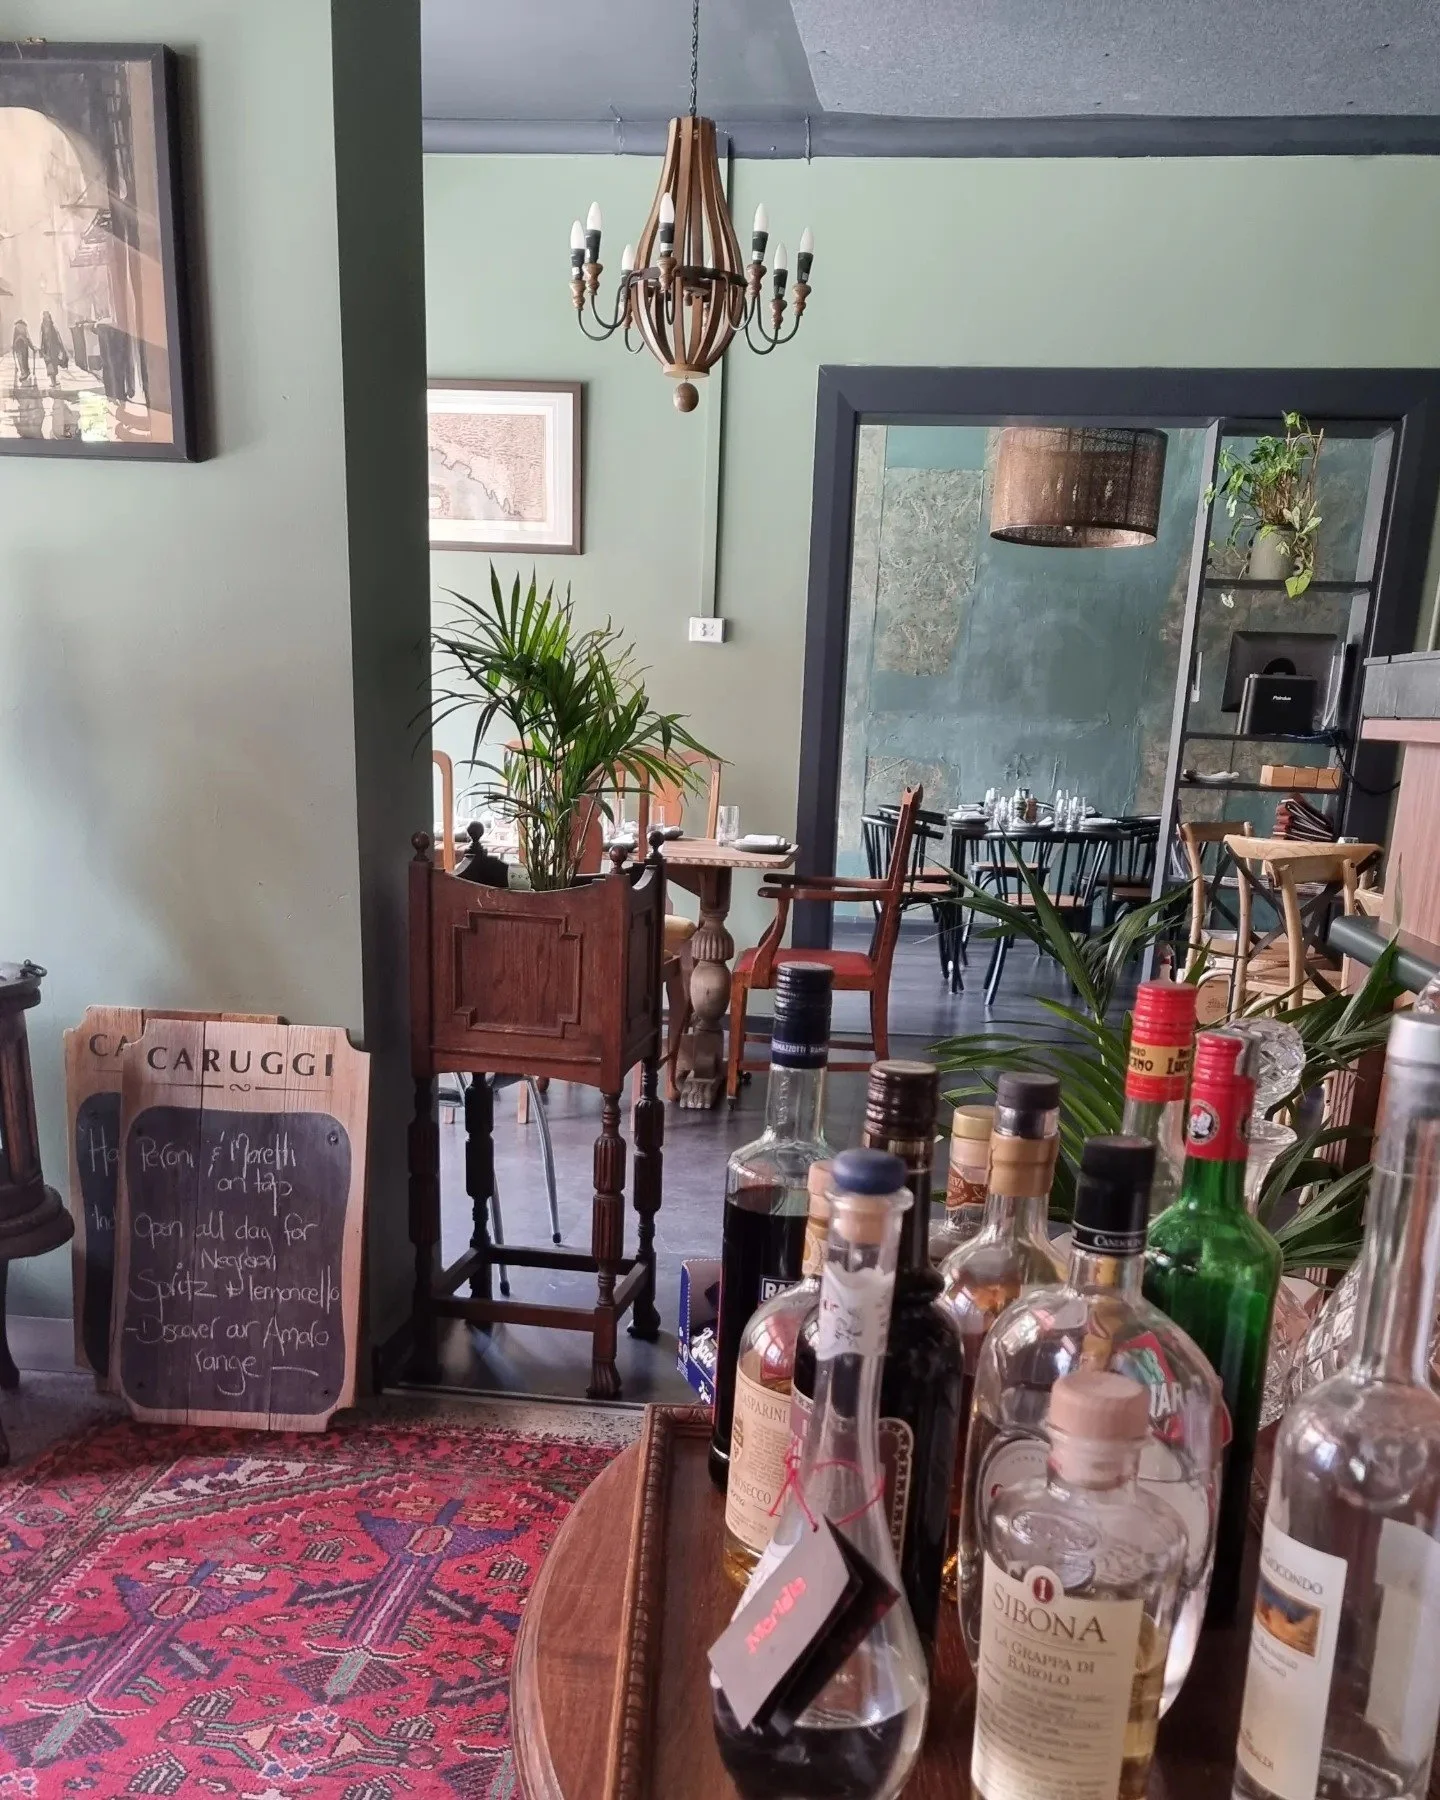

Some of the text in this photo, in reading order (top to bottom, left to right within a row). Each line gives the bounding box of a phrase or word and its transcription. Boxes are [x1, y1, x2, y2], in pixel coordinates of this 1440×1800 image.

[89, 1034, 130, 1057] CA
[147, 1046, 333, 1077] CARUGGI
[137, 1137, 194, 1172] Peroni
[231, 1131, 296, 1178] Moretti
[217, 1176, 247, 1193] on
[134, 1210, 318, 1258] Open all day for
[130, 1262, 217, 1321] Spritz
[195, 1348, 263, 1396] range
[992, 1582, 1107, 1643] SIBONA
[1011, 1640, 1073, 1671] GRAPPA
[1076, 1660, 1095, 1674] DI
